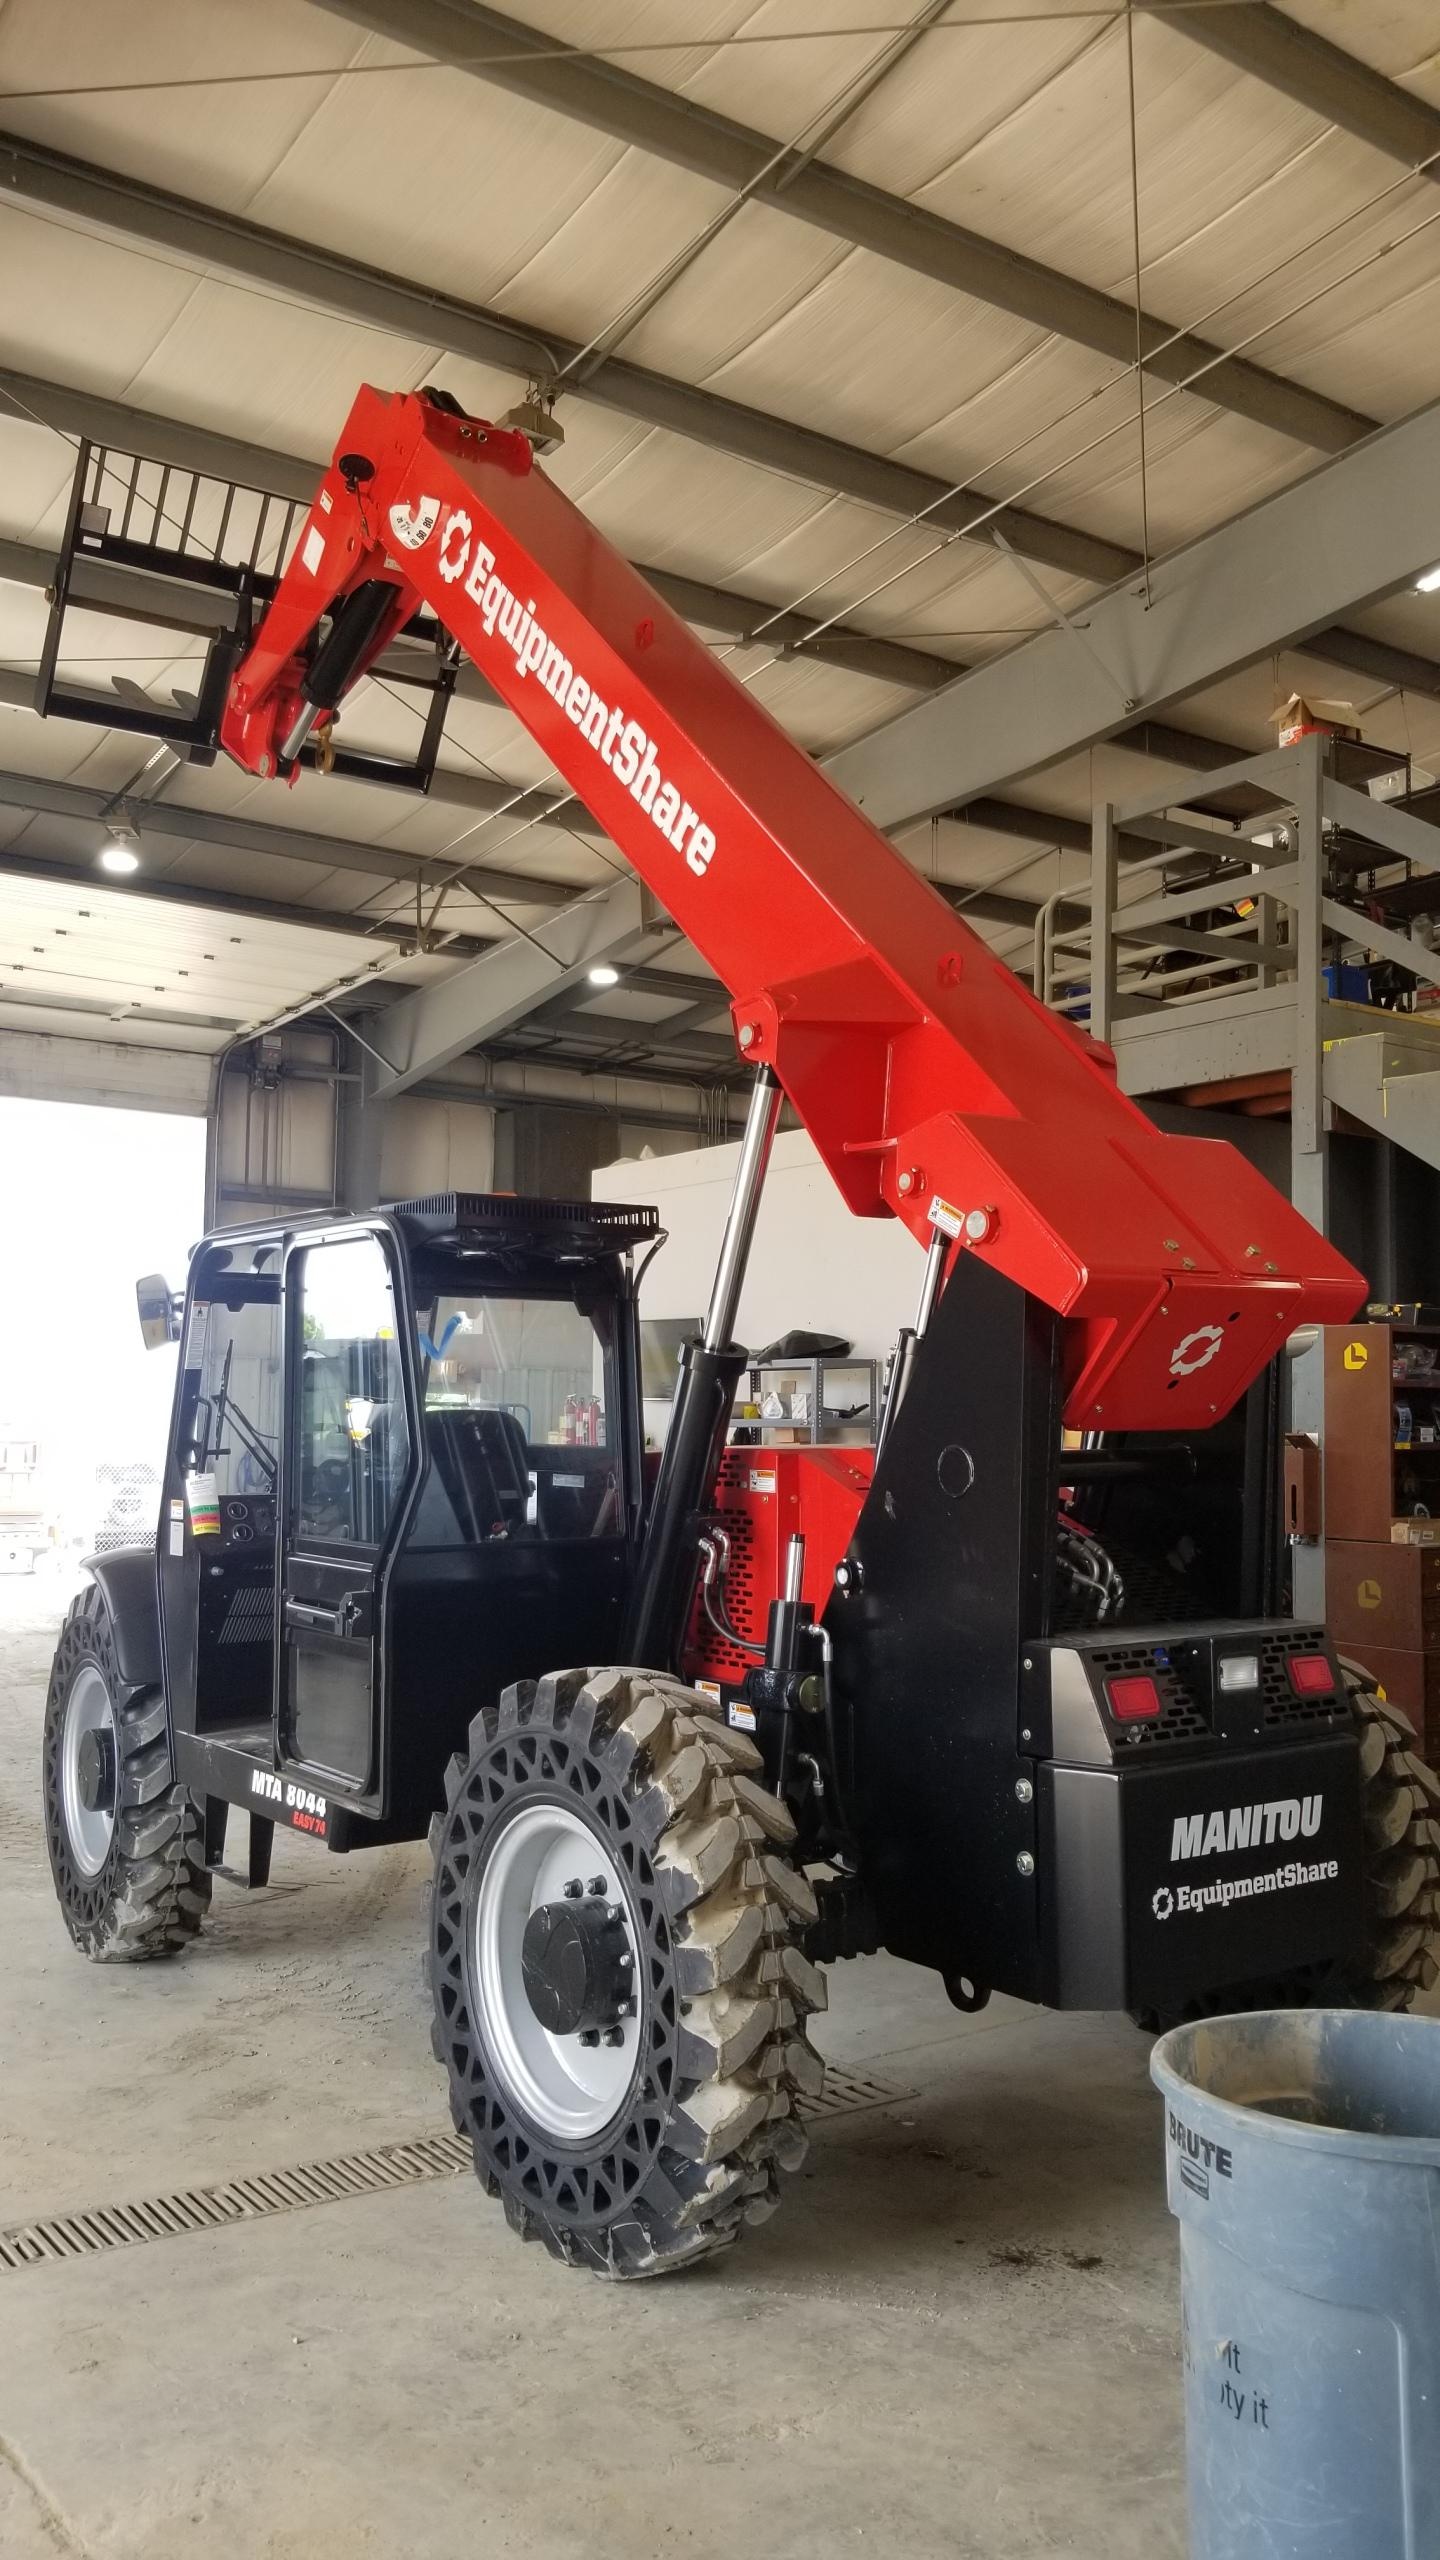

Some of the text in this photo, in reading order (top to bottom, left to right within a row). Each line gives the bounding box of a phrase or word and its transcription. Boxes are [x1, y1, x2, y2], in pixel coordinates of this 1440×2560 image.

[423, 516, 434, 529] 80
[464, 540, 717, 877] EquipmentShare
[251, 1769, 326, 1818] MTA 8044
[293, 1810, 326, 1836] EASY 74
[1171, 1795, 1323, 1861] MANITOU
[1176, 1860, 1339, 1912] EquipmentShare
[1169, 2110, 1232, 2179] BRUTE
[1253, 2390, 1269, 2429] it
